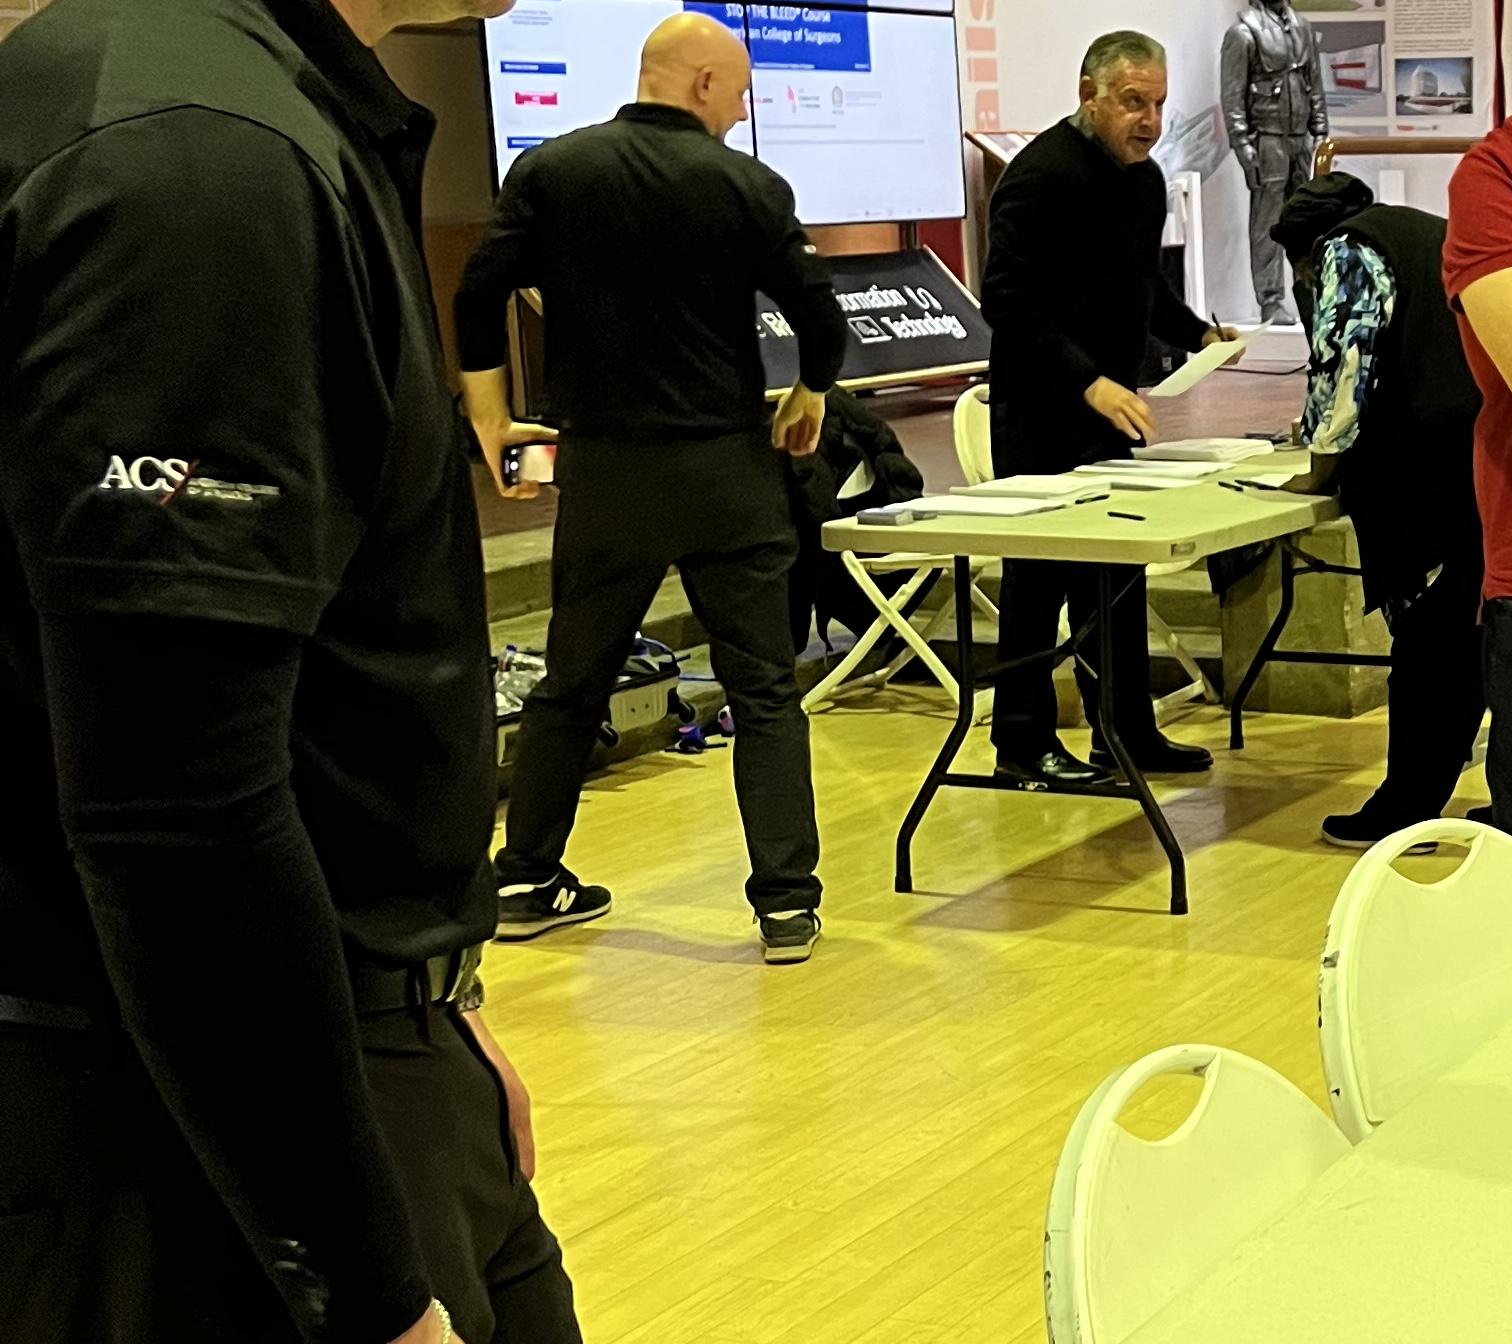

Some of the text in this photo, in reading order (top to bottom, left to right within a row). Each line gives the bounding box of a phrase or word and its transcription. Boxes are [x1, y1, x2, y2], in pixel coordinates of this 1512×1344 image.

[751, 5, 769, 21] THE
[801, 7, 832, 24] Course
[761, 26, 793, 45] College
[794, 27, 804, 42] of
[804, 28, 842, 46] Surgeons
[880, 311, 968, 341] Technology
[98, 455, 191, 493] ACS
